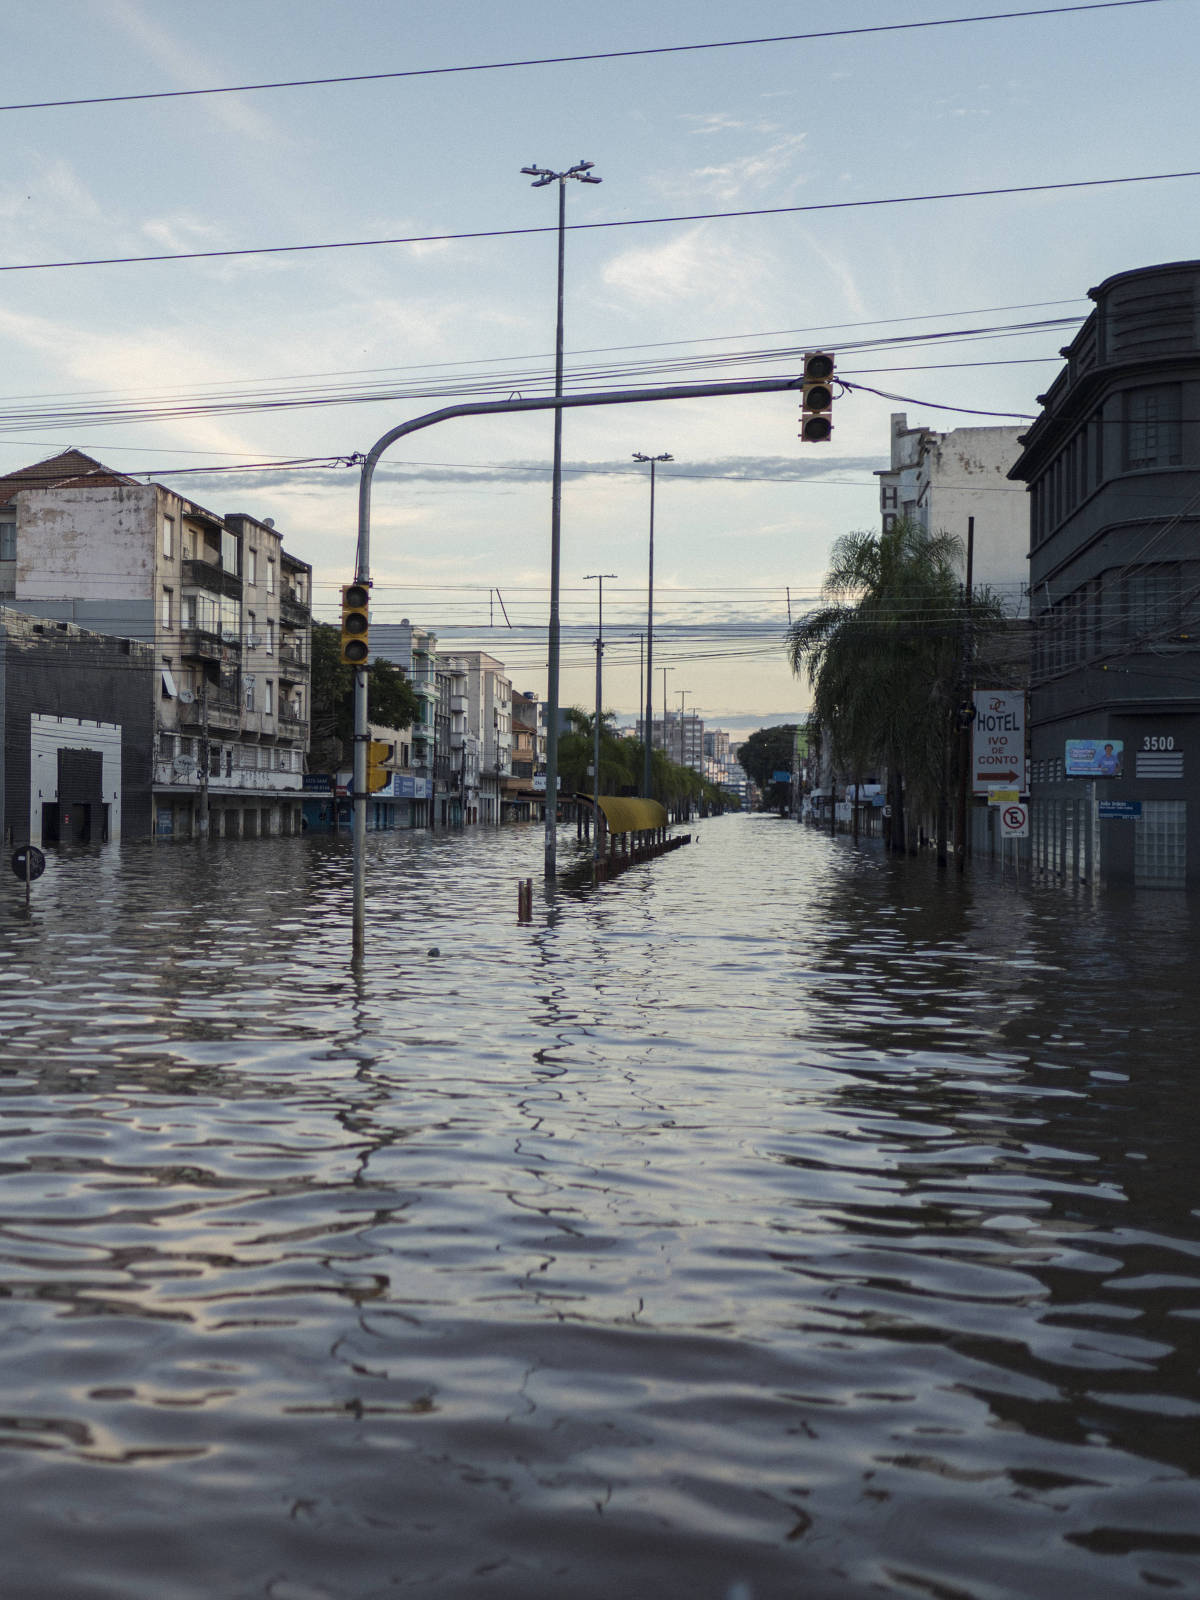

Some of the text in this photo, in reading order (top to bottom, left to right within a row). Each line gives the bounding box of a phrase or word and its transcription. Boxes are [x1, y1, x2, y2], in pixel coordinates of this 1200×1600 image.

[977, 711, 1020, 732] HOTEL
[988, 736, 1008, 745] IVO
[1143, 736, 1174, 751] 3500
[978, 756, 1018, 765] CONTO
